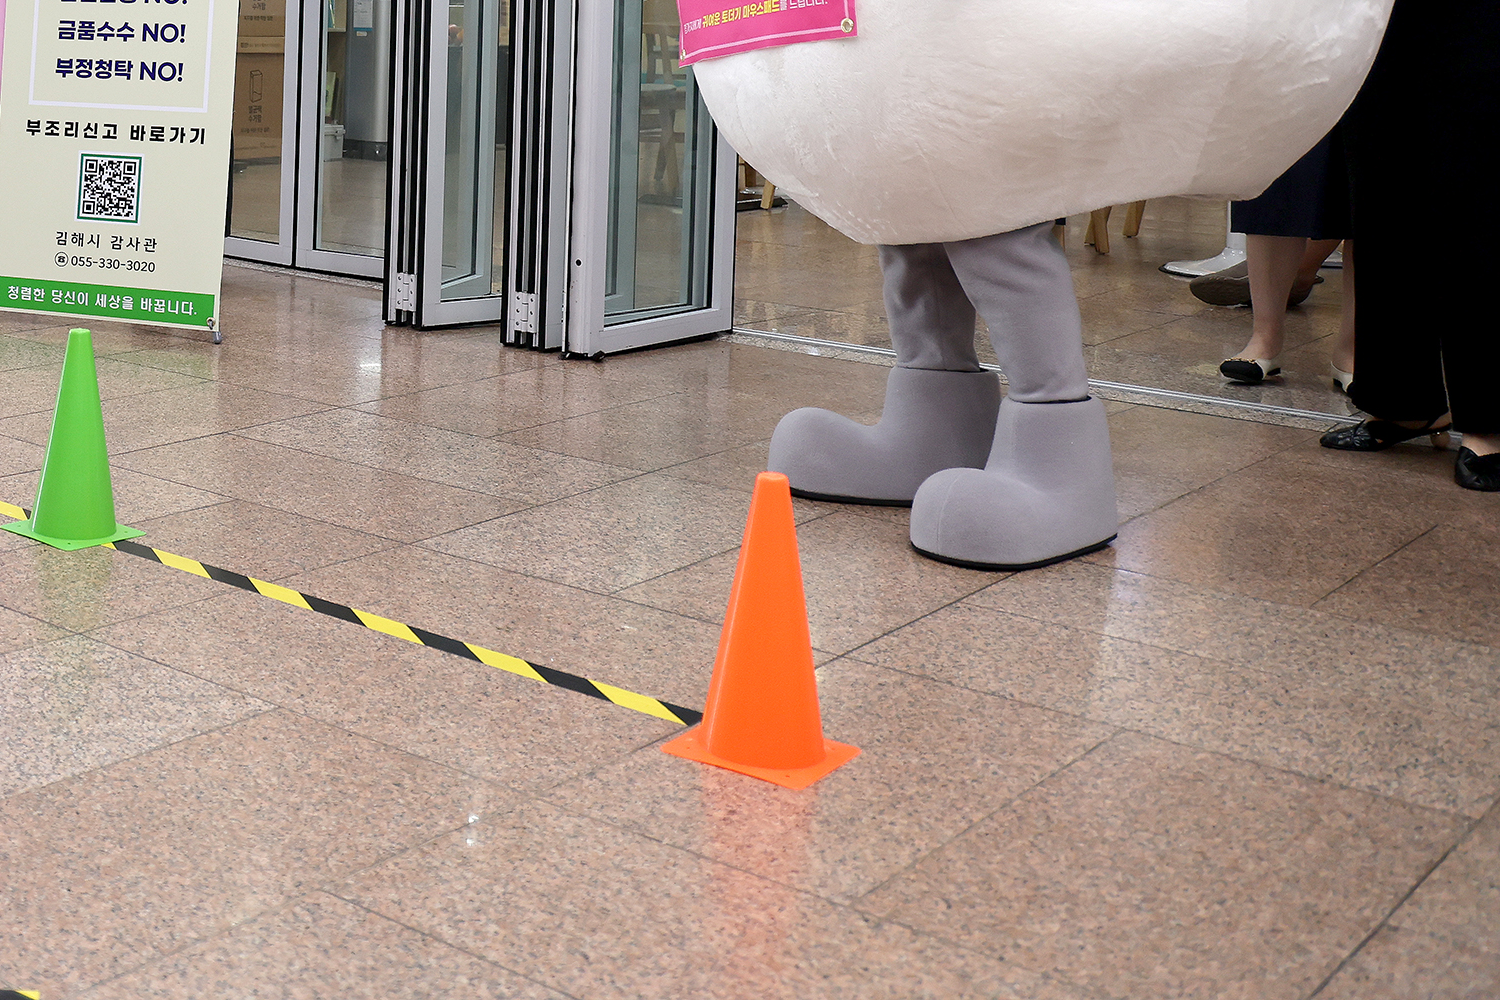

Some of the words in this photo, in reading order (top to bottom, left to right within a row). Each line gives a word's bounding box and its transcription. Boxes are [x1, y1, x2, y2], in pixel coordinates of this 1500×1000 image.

[702, 11, 721, 29] 귀여운
[721, 6, 742, 24] 토더기
[58, 20, 135, 42] 금품수수
[141, 23, 186, 43] NO!
[55, 58, 134, 80] 부정청탁
[139, 61, 184, 82] NO!
[26, 119, 118, 140] 부조리신고
[130, 125, 206, 145] 바로가기
[55, 231, 100, 249] 김해시
[110, 235, 158, 253] 감사관
[71, 255, 156, 273] 055-330-3020
[7, 285, 45, 303] 청렴한
[51, 289, 89, 306] 당신이
[94, 293, 134, 311] 세상을
[140, 297, 198, 317] 바꿉니다.
